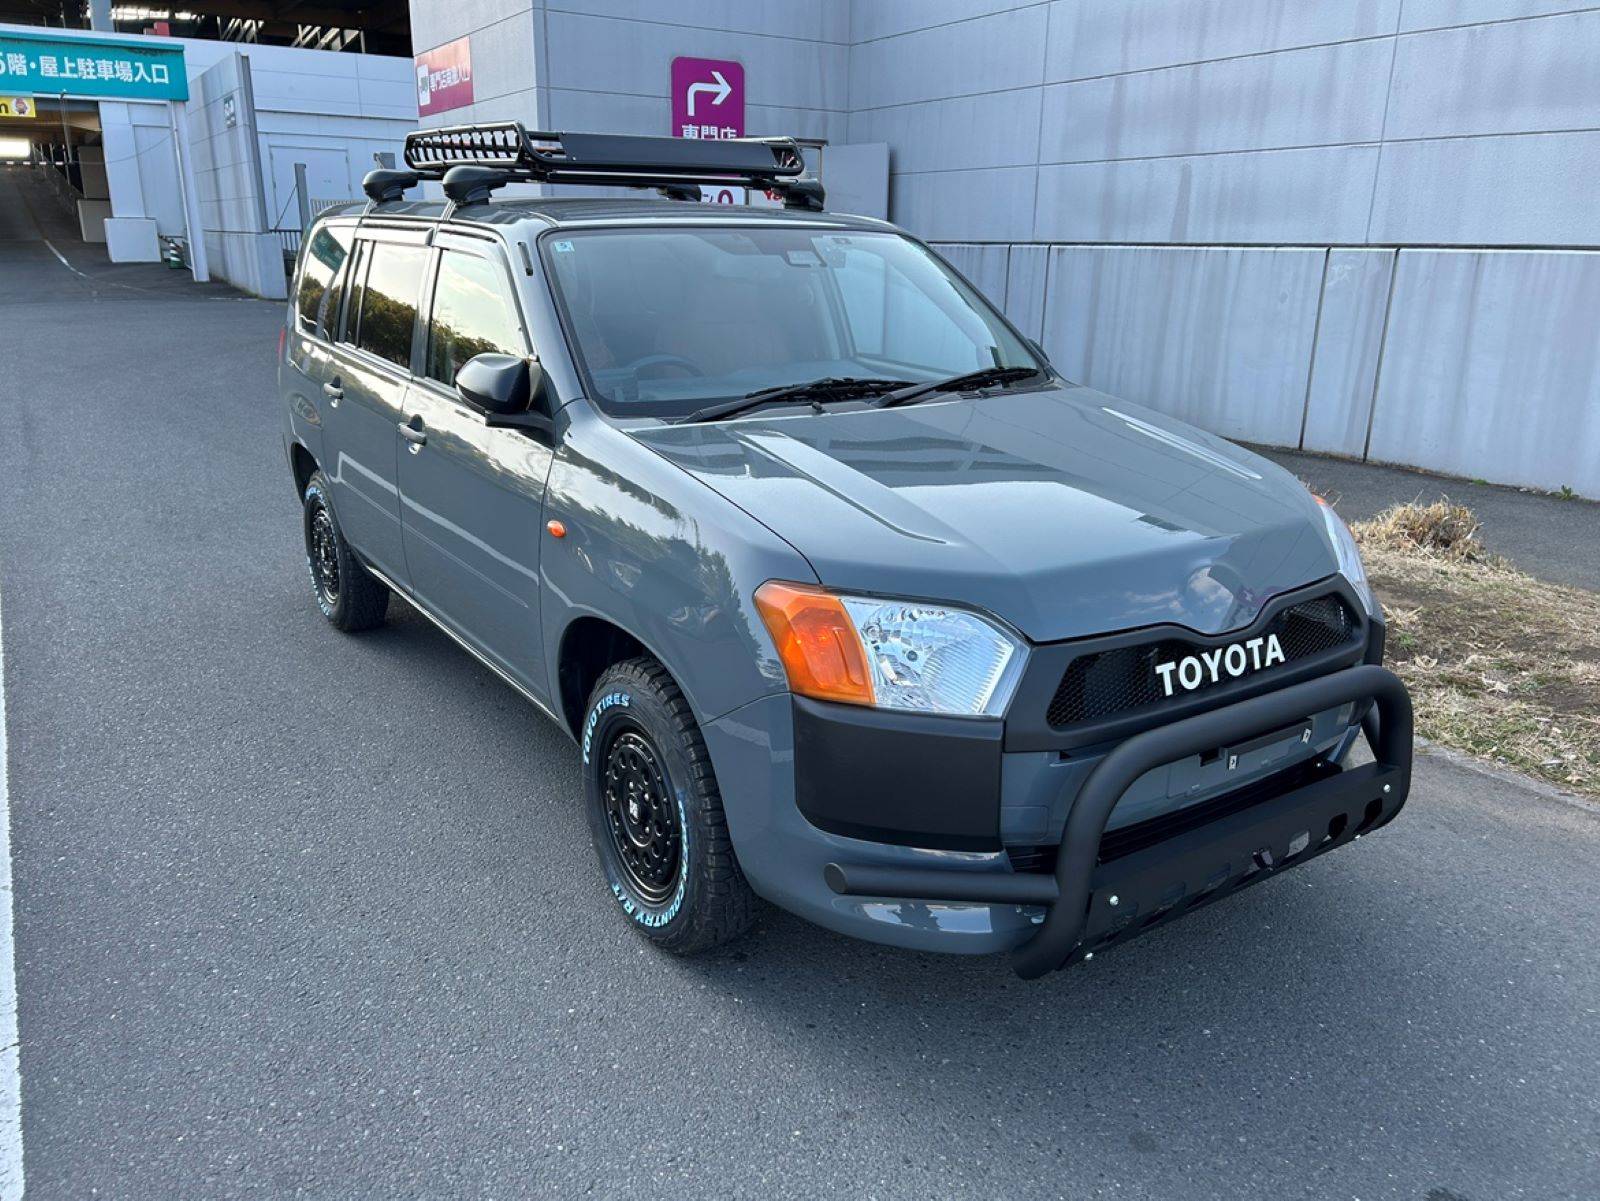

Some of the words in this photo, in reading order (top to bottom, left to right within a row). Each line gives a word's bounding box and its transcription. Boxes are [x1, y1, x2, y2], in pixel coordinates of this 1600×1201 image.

[681, 124, 737, 139] 専門店
[1155, 633, 1285, 696] TOYOTA
[596, 692, 631, 715] TIRES
[635, 882, 685, 928] COUNTRY
